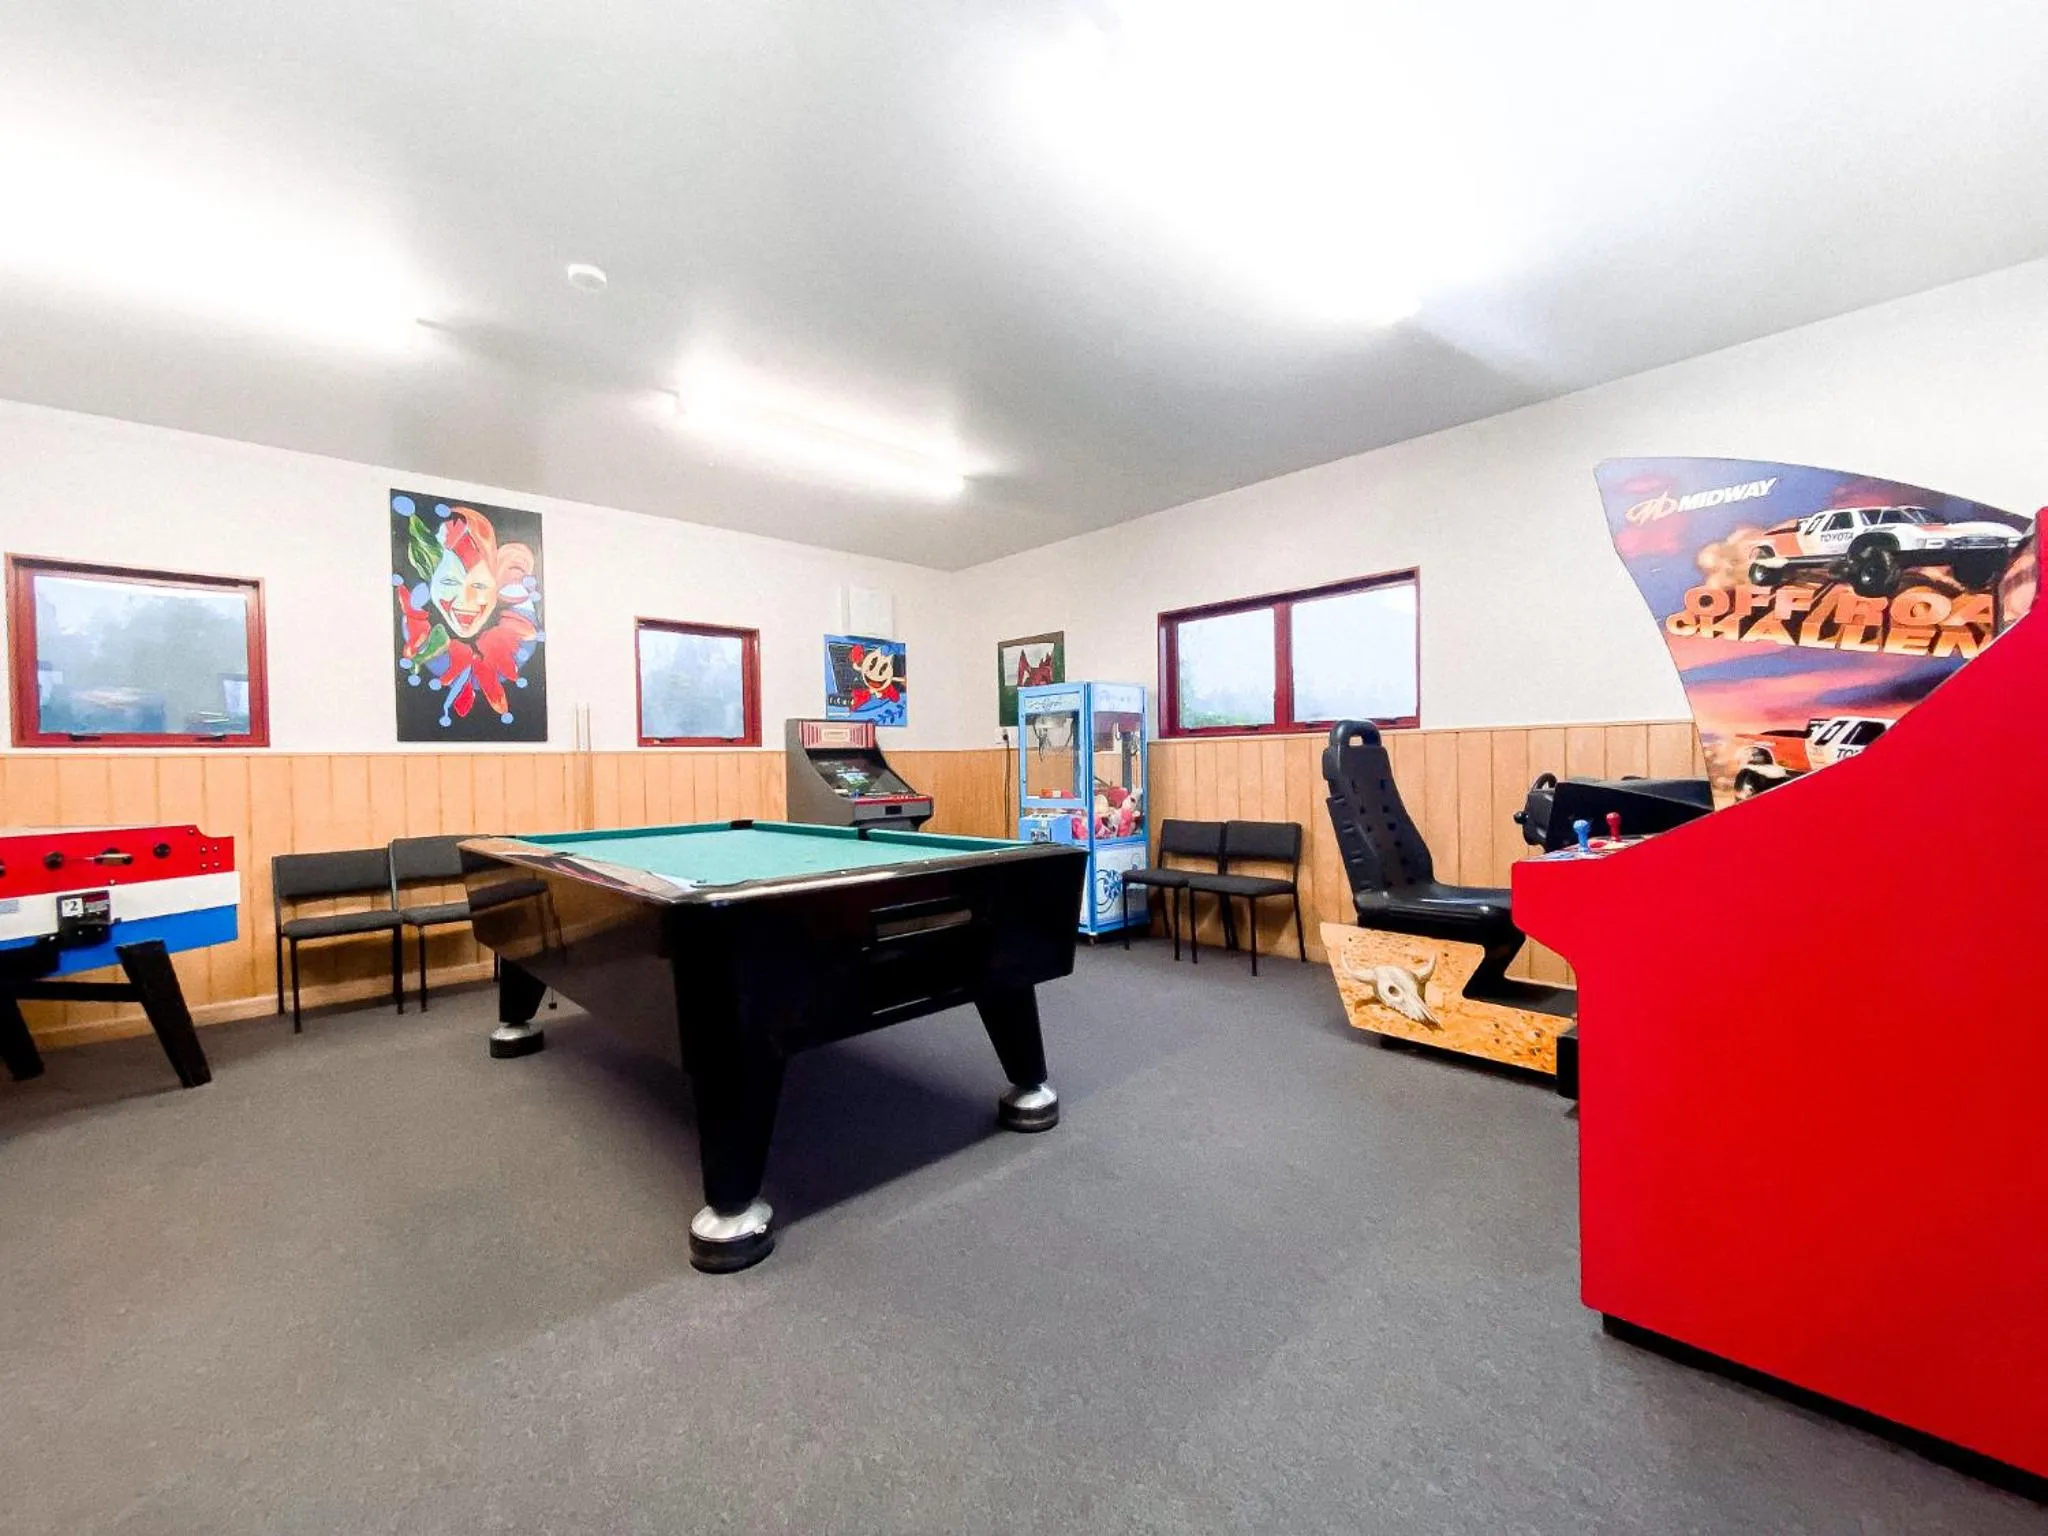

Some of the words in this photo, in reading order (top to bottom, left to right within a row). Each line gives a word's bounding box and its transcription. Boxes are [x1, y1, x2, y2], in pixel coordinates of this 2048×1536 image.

[1679, 477, 1777, 512] MIDWAY
[1820, 532, 1854, 542] TOYOTA
[1684, 584, 1817, 620] OFF
